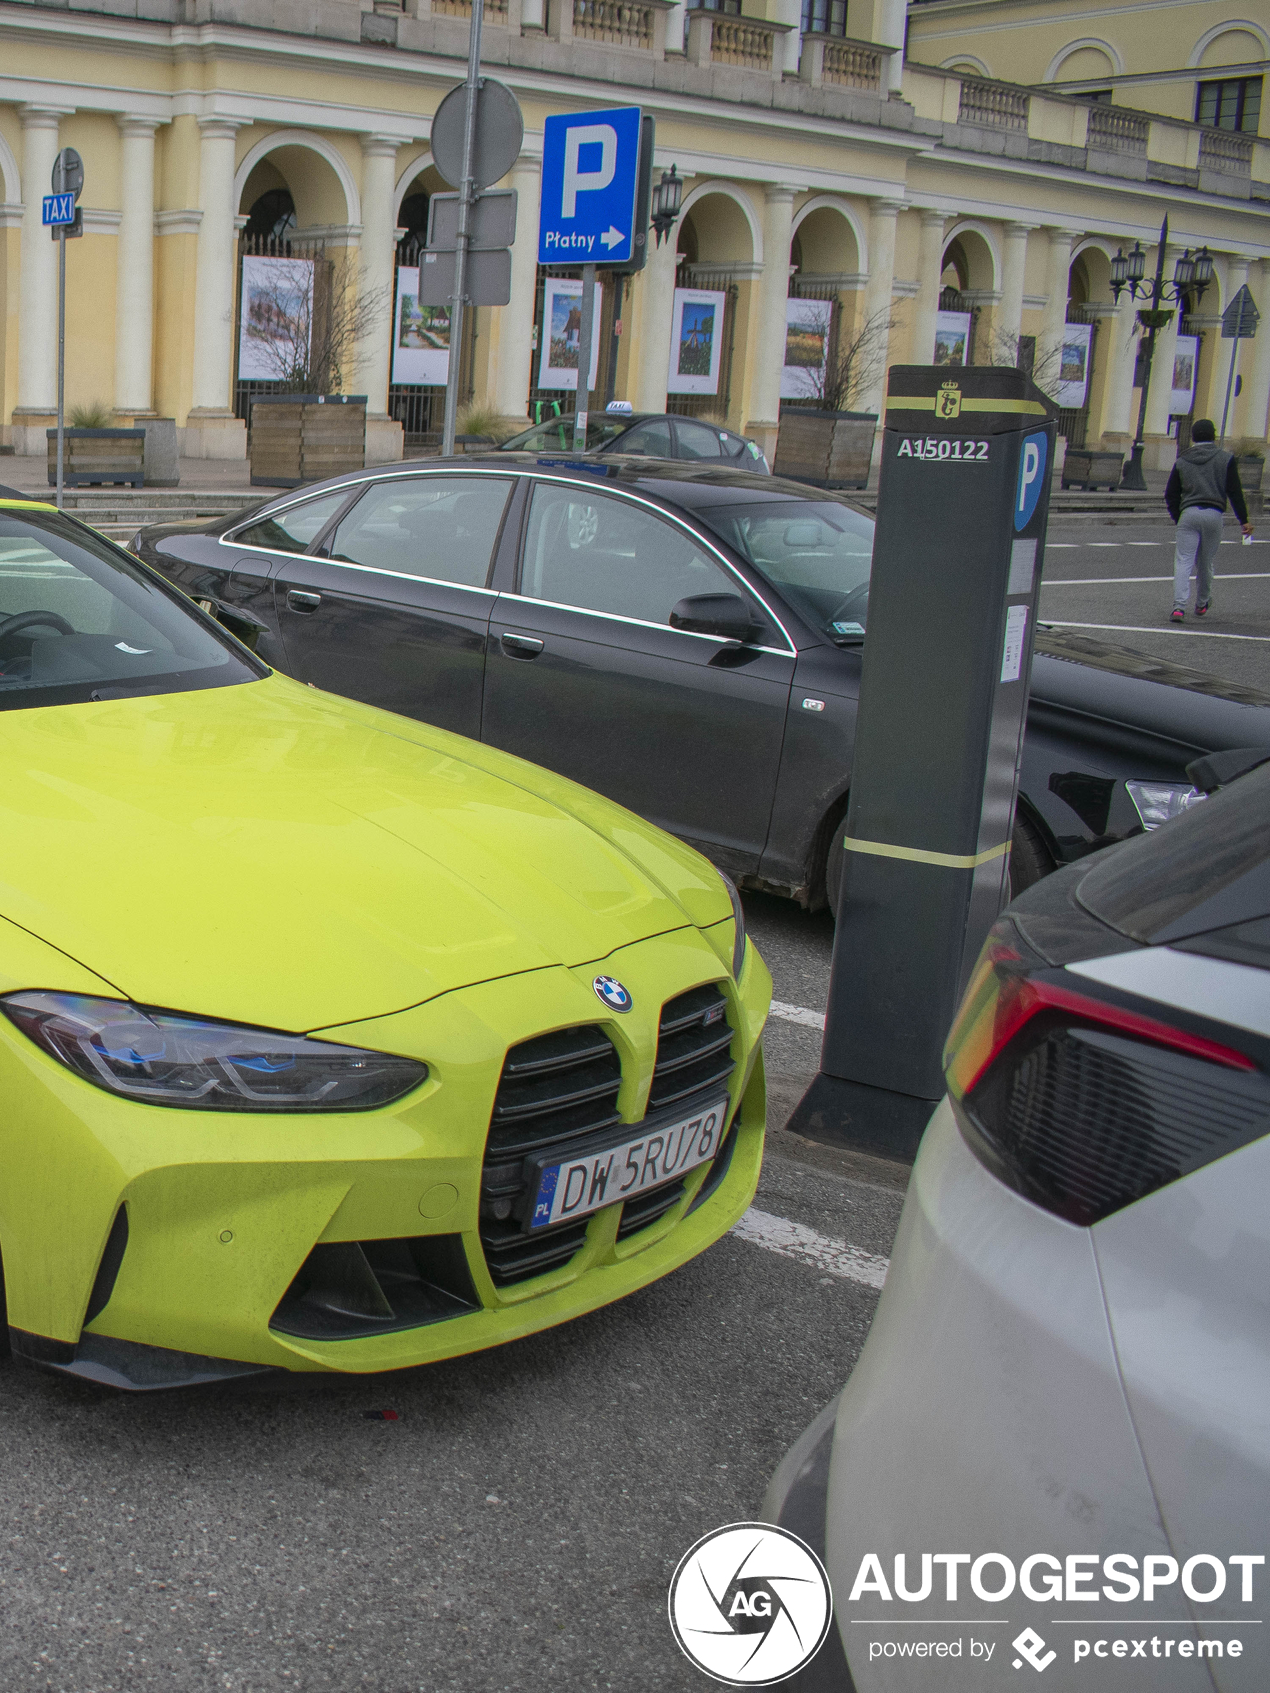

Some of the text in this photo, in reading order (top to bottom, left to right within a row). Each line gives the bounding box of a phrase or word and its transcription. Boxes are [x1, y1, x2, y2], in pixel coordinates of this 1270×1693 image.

[561, 123, 618, 219] P
[43, 195, 73, 222] TAXI
[545, 230, 596, 253] Płatny
[897, 438, 990, 460] A150122
[1018, 442, 1039, 512] P
[560, 1112, 717, 1215] DW 5RU78
[534, 1202, 550, 1218] PL
